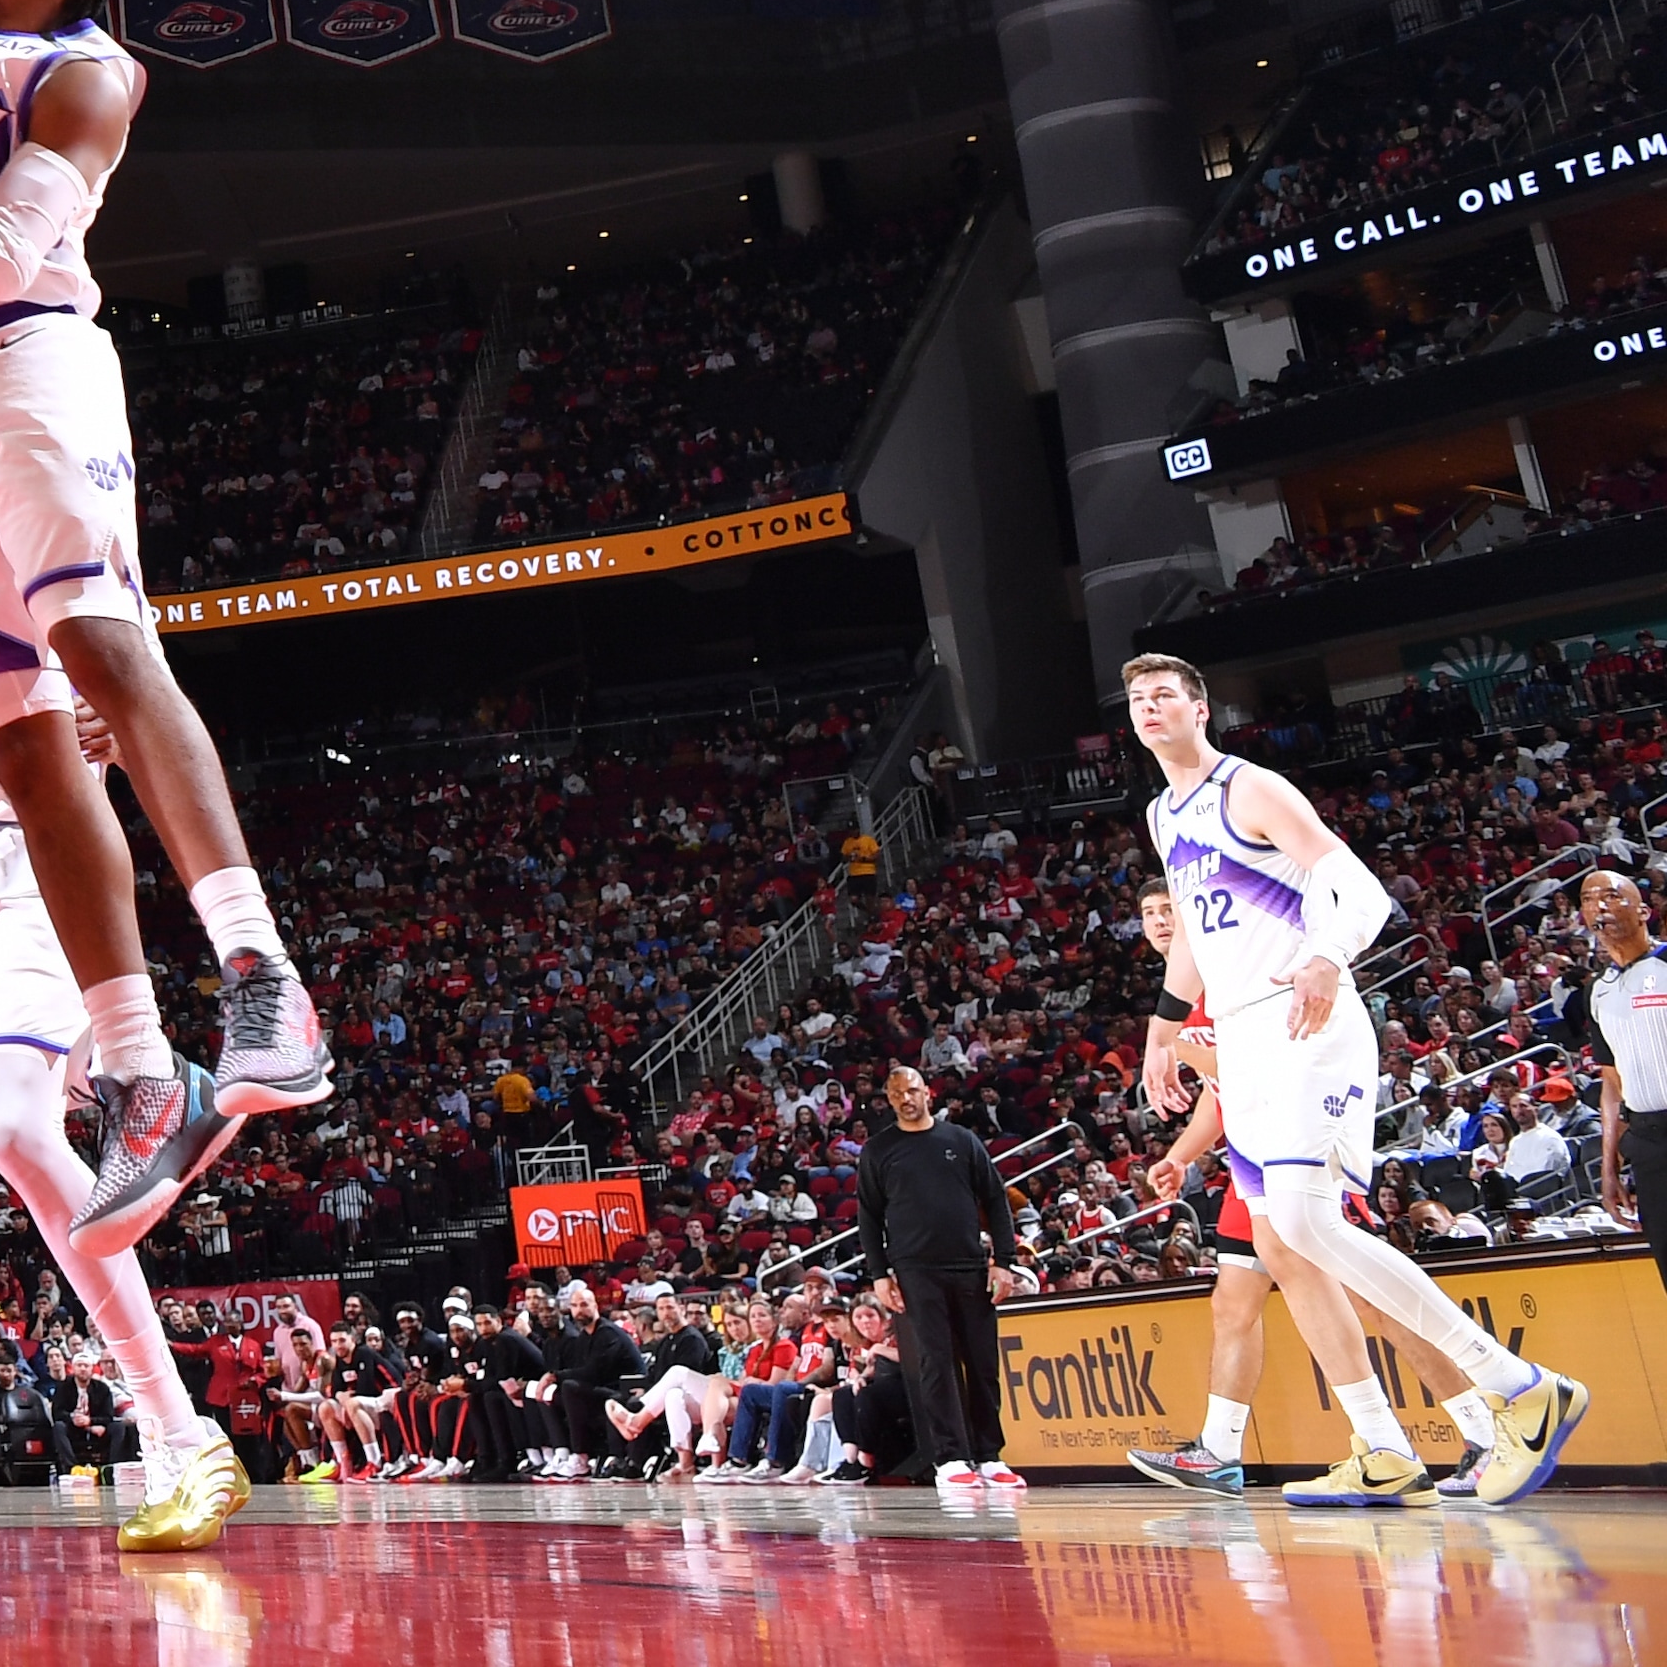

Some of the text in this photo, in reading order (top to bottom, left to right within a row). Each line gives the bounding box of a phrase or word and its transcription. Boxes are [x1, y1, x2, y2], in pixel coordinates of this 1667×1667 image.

[1246, 133, 1667, 277] ONE CALL. ONE TEAM
[1594, 328, 1666, 361] ONE
[1173, 447, 1202, 472] CC
[215, 586, 311, 622] TEAM.
[320, 568, 423, 607] TOTAL
[433, 546, 617, 592] RECOVERY.
[1194, 889, 1240, 935] 22
[561, 1207, 631, 1237] PNC
[1005, 1325, 1166, 1421] Fanttik
[1039, 1424, 1175, 1448] The Next-Gen Power Tools
